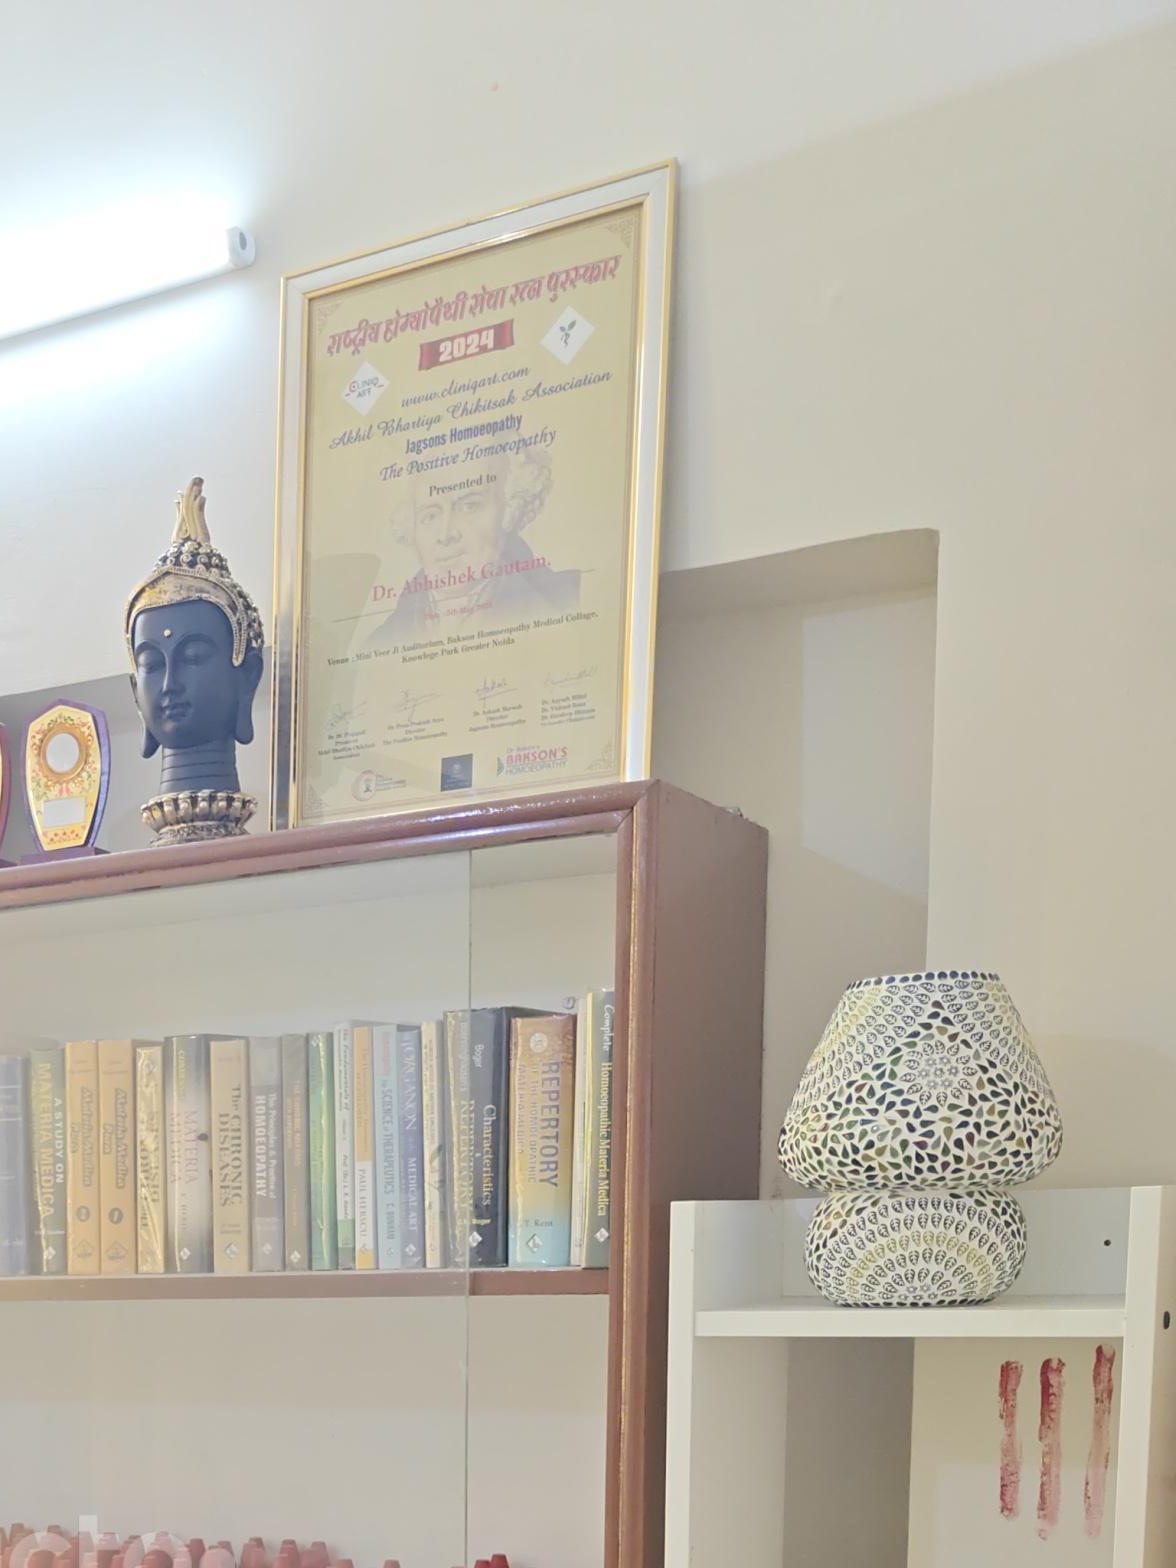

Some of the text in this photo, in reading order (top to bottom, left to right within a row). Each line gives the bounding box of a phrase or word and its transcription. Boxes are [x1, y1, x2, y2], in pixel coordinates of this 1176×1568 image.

[439, 329, 495, 363] 2024
[329, 369, 612, 451] Akhil Bhartiya Chikitsak Association
[401, 367, 530, 407] www.cliniqart.com
[379, 427, 556, 481] The Positive Homoeopathy
[405, 414, 523, 455] Jagsons Homoeopathy
[429, 472, 497, 498] Presented to
[372, 555, 552, 602] Dr. Abhishek Gautam.
[327, 653, 348, 667] Venue
[532, 615, 563, 630] Medical
[506, 746, 568, 766] BAKSON'S
[473, 1043, 485, 1069] Boger
[529, 1079, 538, 1095] THE
[103, 1122, 114, 1155] Pura
[114, 1087, 129, 1190] Materia Medica
[382, 1088, 394, 1126] SCIENCE
[404, 1044, 418, 1233] ORGANON MEDICAL ART
[538, 1061, 561, 1188] REPERTORY
[597, 1004, 616, 1216] Complete Homoeopathic Materia Medica
[38, 1062, 55, 1218] MATERIA MEDICA
[54, 1097, 64, 1184] A STUDY ON
[183, 1109, 199, 1185] MATERIA
[219, 1112, 231, 1208] DISEASES
[231, 1085, 243, 1205] The CHRONIC
[255, 1095, 266, 1198] HOMOEOPATHY
[382, 1132, 395, 1195] THERAPEUTICS
[460, 1099, 475, 1210] REPERTORY
[481, 1103, 496, 1206] Characteristics
[527, 1101, 538, 1184] HOMOEOPATHIC
[358, 1168, 369, 1193] PAUL
[534, 1218, 554, 1229] Kent
